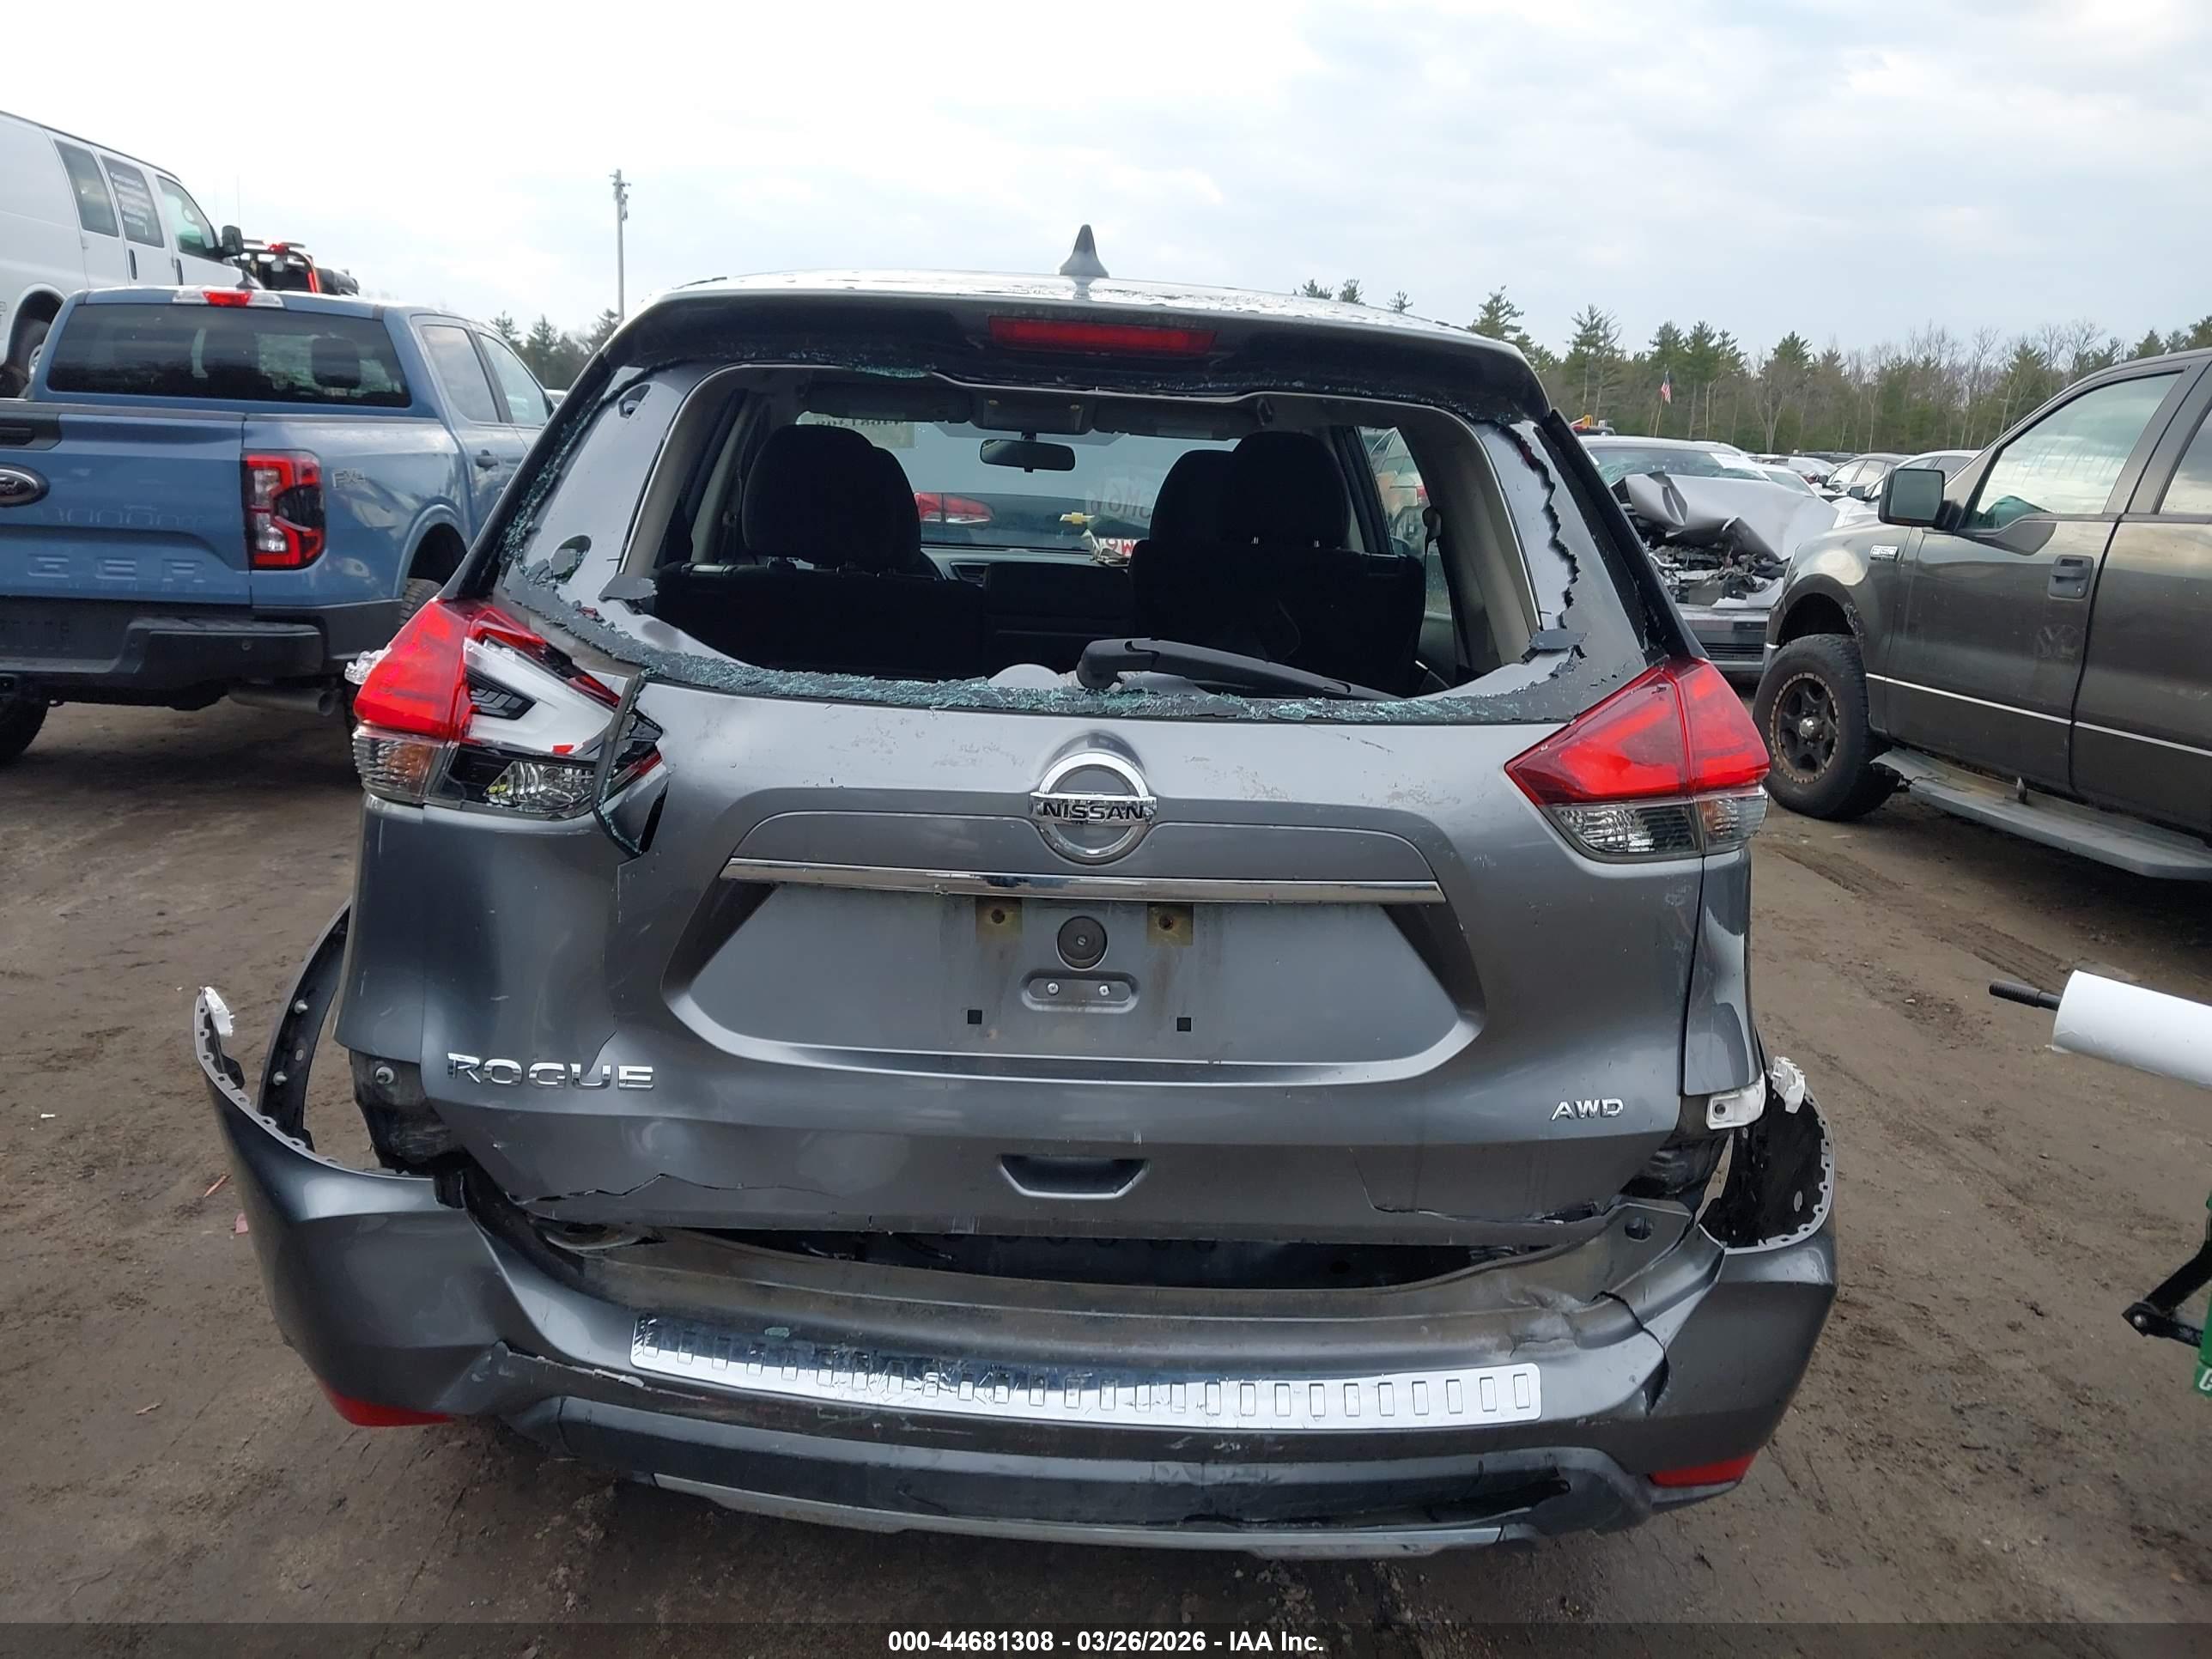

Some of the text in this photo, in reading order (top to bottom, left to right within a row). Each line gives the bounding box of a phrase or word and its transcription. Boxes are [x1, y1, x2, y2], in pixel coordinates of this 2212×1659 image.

[1042, 801, 1145, 822] NISSAN
[447, 1052, 654, 1090] ROGUE
[1549, 1097, 1624, 1121] AWD
